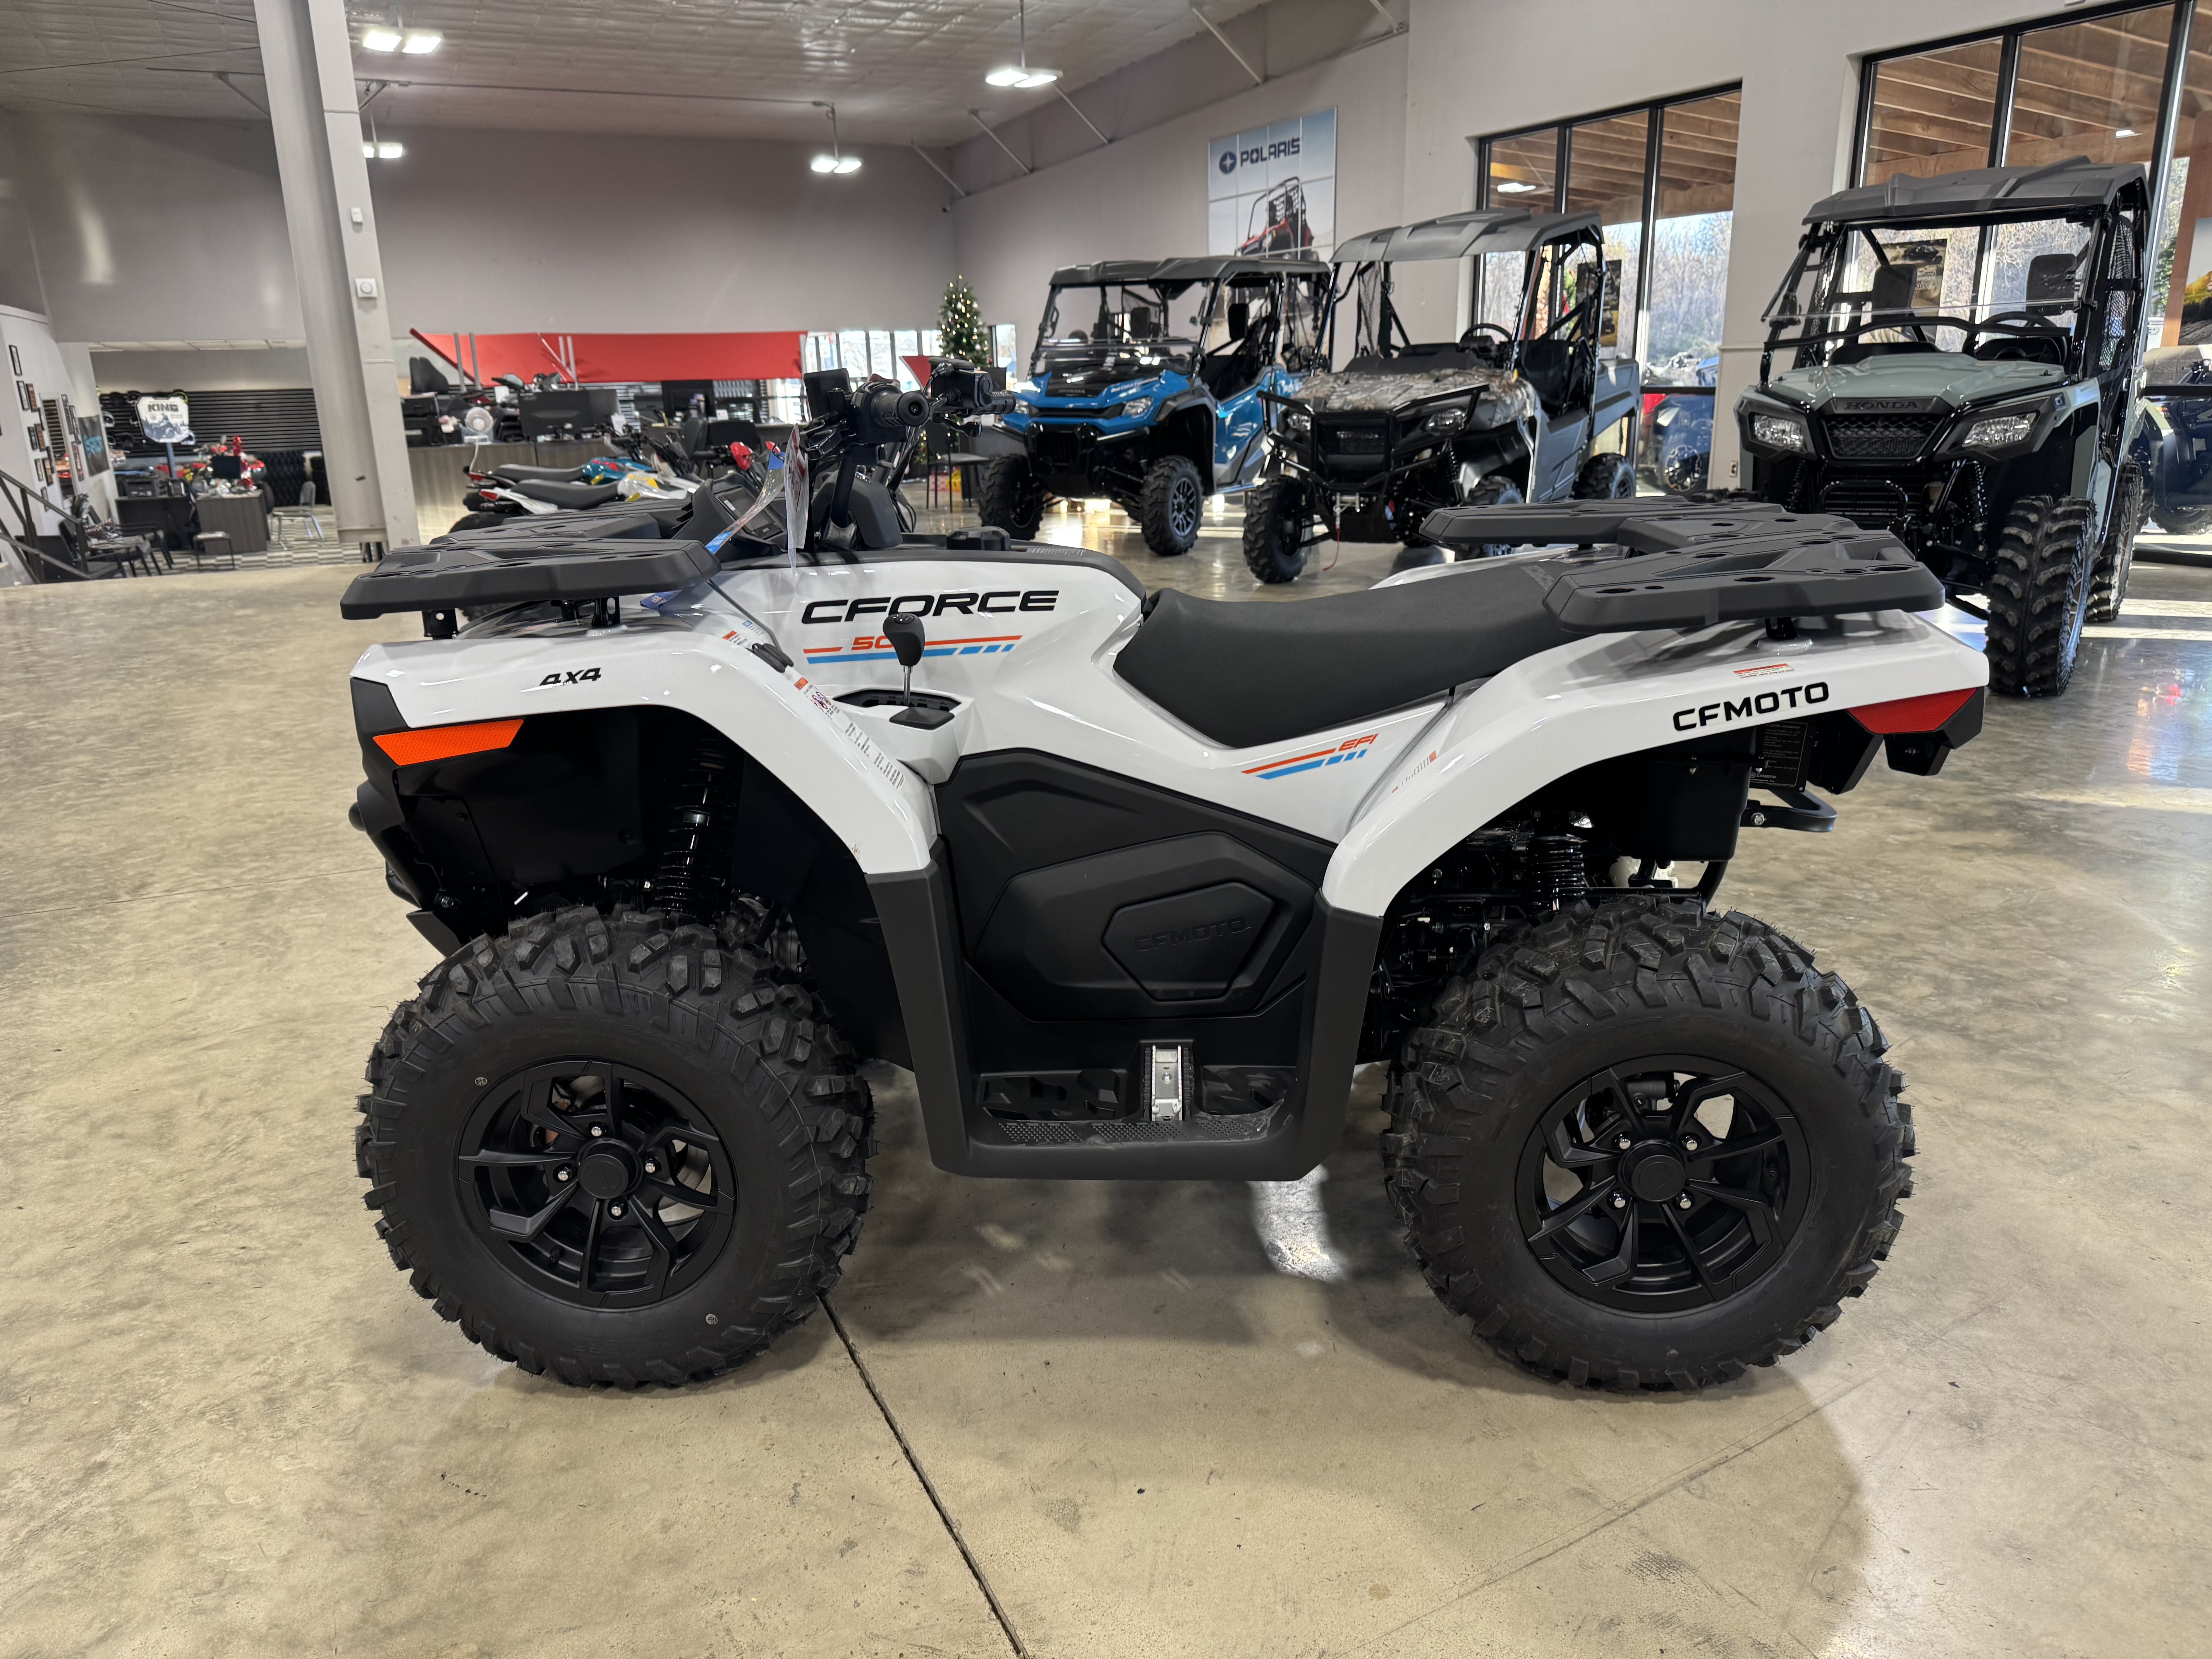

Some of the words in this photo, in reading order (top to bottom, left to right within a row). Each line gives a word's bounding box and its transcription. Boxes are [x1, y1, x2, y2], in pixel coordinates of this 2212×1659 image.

[1240, 137, 1300, 167] POLARIS
[148, 404, 179, 412] KING
[1844, 402, 1917, 410] HONDA
[801, 590, 1059, 624] CFORCE
[851, 635, 893, 651] 50
[1673, 682, 1829, 731] CFMOTO
[1338, 733, 1379, 751] EFI
[1134, 917, 1246, 951] CFMOTO
